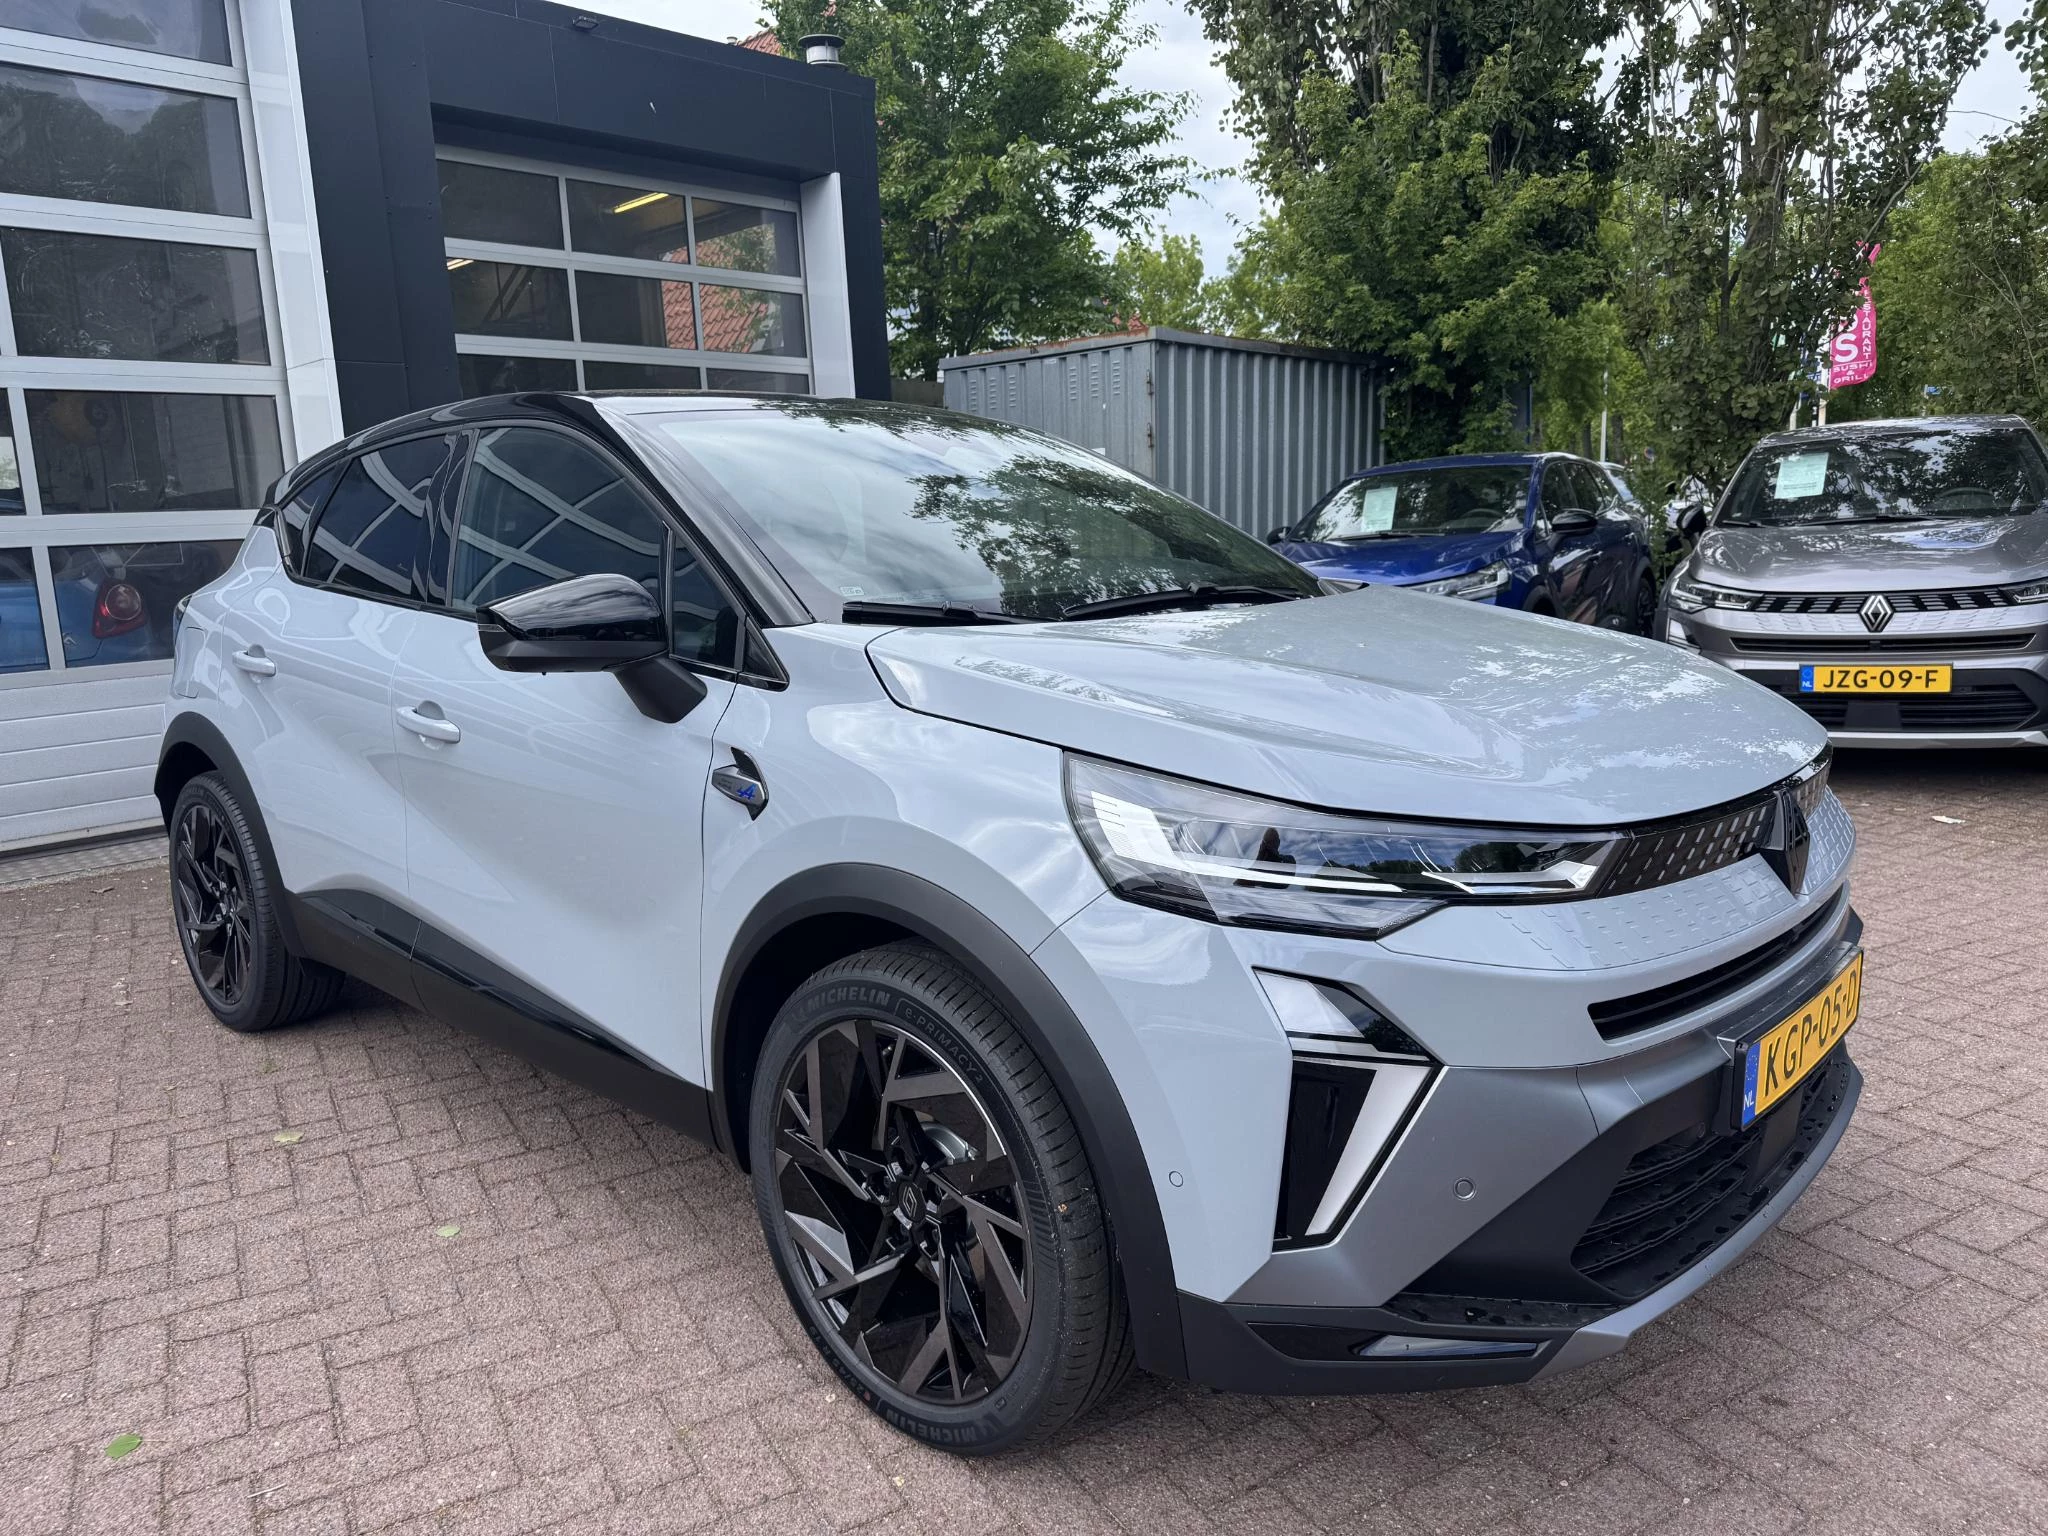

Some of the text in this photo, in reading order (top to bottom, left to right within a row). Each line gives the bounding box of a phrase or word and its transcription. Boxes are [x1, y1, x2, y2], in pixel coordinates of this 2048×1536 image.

[1834, 361, 1873, 372] SUSHI
[1833, 373, 1869, 384] GRILL
[1823, 669, 1939, 689] JZG-09-F
[807, 986, 891, 1013] MICHELIN
[1764, 970, 1857, 1097] KGP-05-D
[1743, 1090, 1754, 1110] NL
[886, 1408, 977, 1443] MICHELIN
